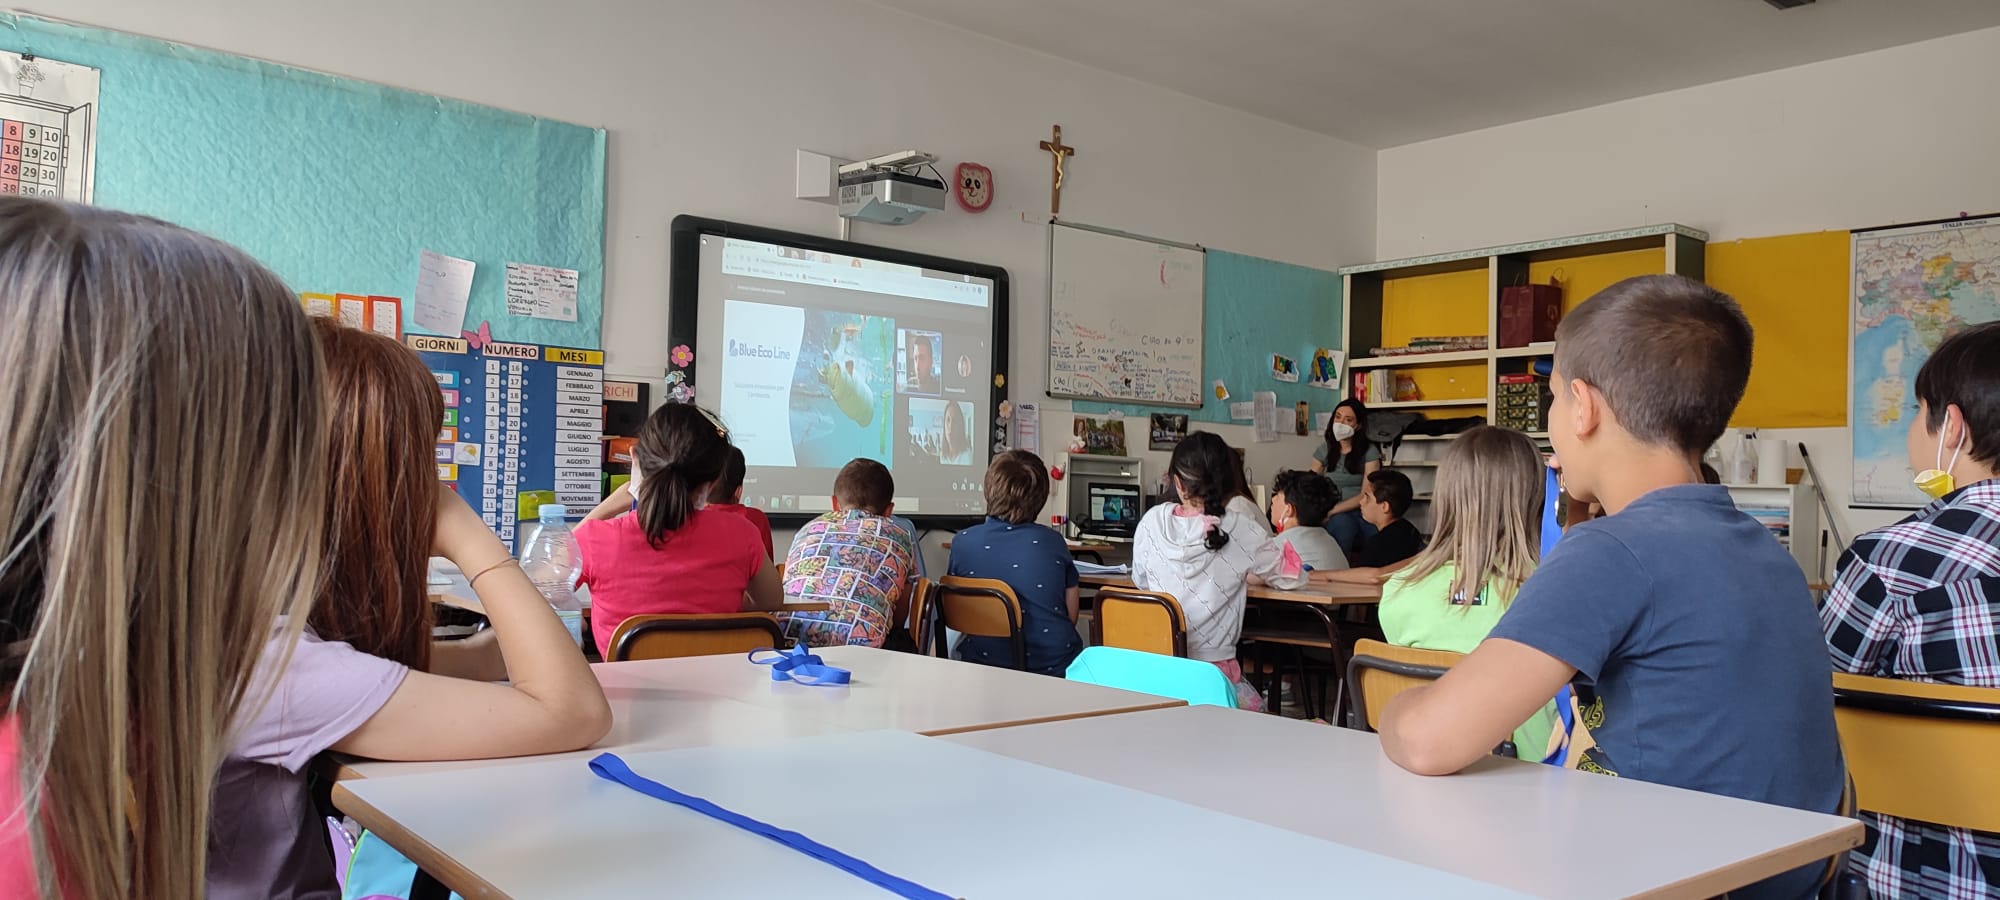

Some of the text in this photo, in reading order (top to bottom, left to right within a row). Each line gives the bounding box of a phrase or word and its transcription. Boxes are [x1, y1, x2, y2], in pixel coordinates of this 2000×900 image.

[9, 126, 58, 142] 8 9 10
[5, 144, 57, 162] 18 19 20
[3, 163, 56, 181] 28 29 30
[2, 183, 17, 194] 38
[21, 185, 36, 196] 39
[415, 338, 460, 352] GIORNI
[484, 343, 537, 358] NUMERO
[739, 343, 791, 360] Blue Eco Line
[560, 351, 588, 363] MESI
[511, 364, 520, 372] 16
[566, 370, 594, 378] GENNAIO
[510, 378, 520, 386] 17
[565, 382, 594, 390] FEBBRAIO
[603, 385, 634, 398] RICHI
[510, 392, 519, 400] 18
[569, 407, 590, 415] APRILE
[508, 420, 519, 428] 20
[507, 433, 517, 441] 21
[507, 447, 517, 455] 22
[506, 460, 516, 468] 23
[505, 474, 516, 482] 24
[485, 487, 495, 495] 10
[504, 488, 514, 496] 25
[485, 501, 494, 509] 11
[503, 516, 513, 524] 27
